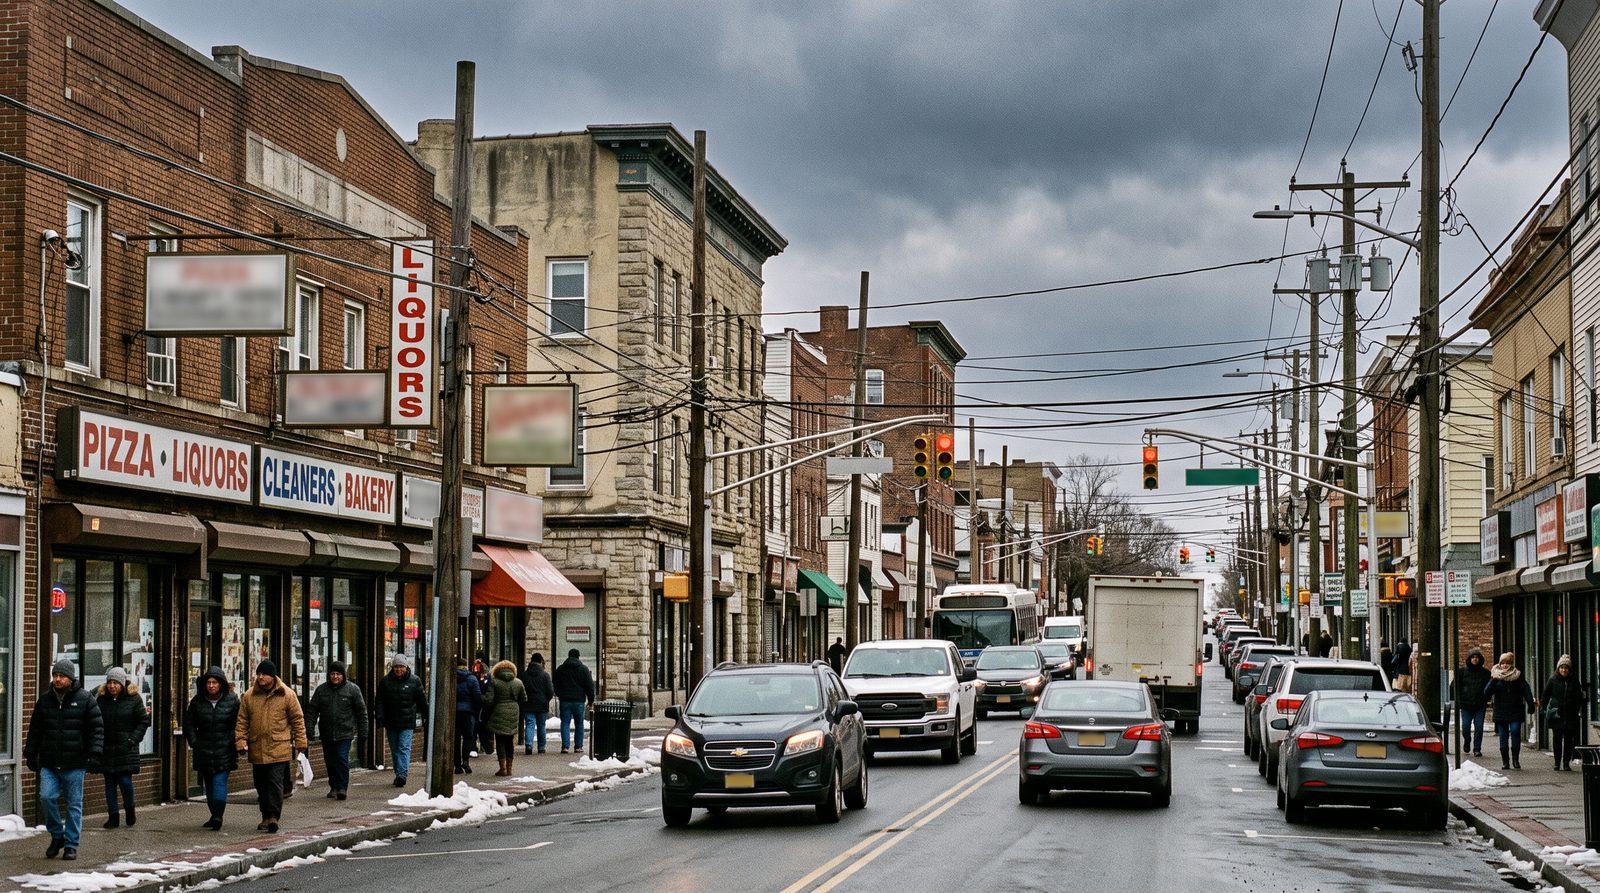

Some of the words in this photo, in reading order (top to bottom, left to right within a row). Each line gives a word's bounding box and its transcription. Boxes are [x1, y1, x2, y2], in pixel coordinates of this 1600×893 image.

[397, 247, 426, 418] LIQUORS
[83, 422, 155, 478] PIZZA
[172, 439, 248, 493] LIQUORS
[262, 456, 336, 506] CLEANERS
[344, 472, 394, 514] BAKERY
